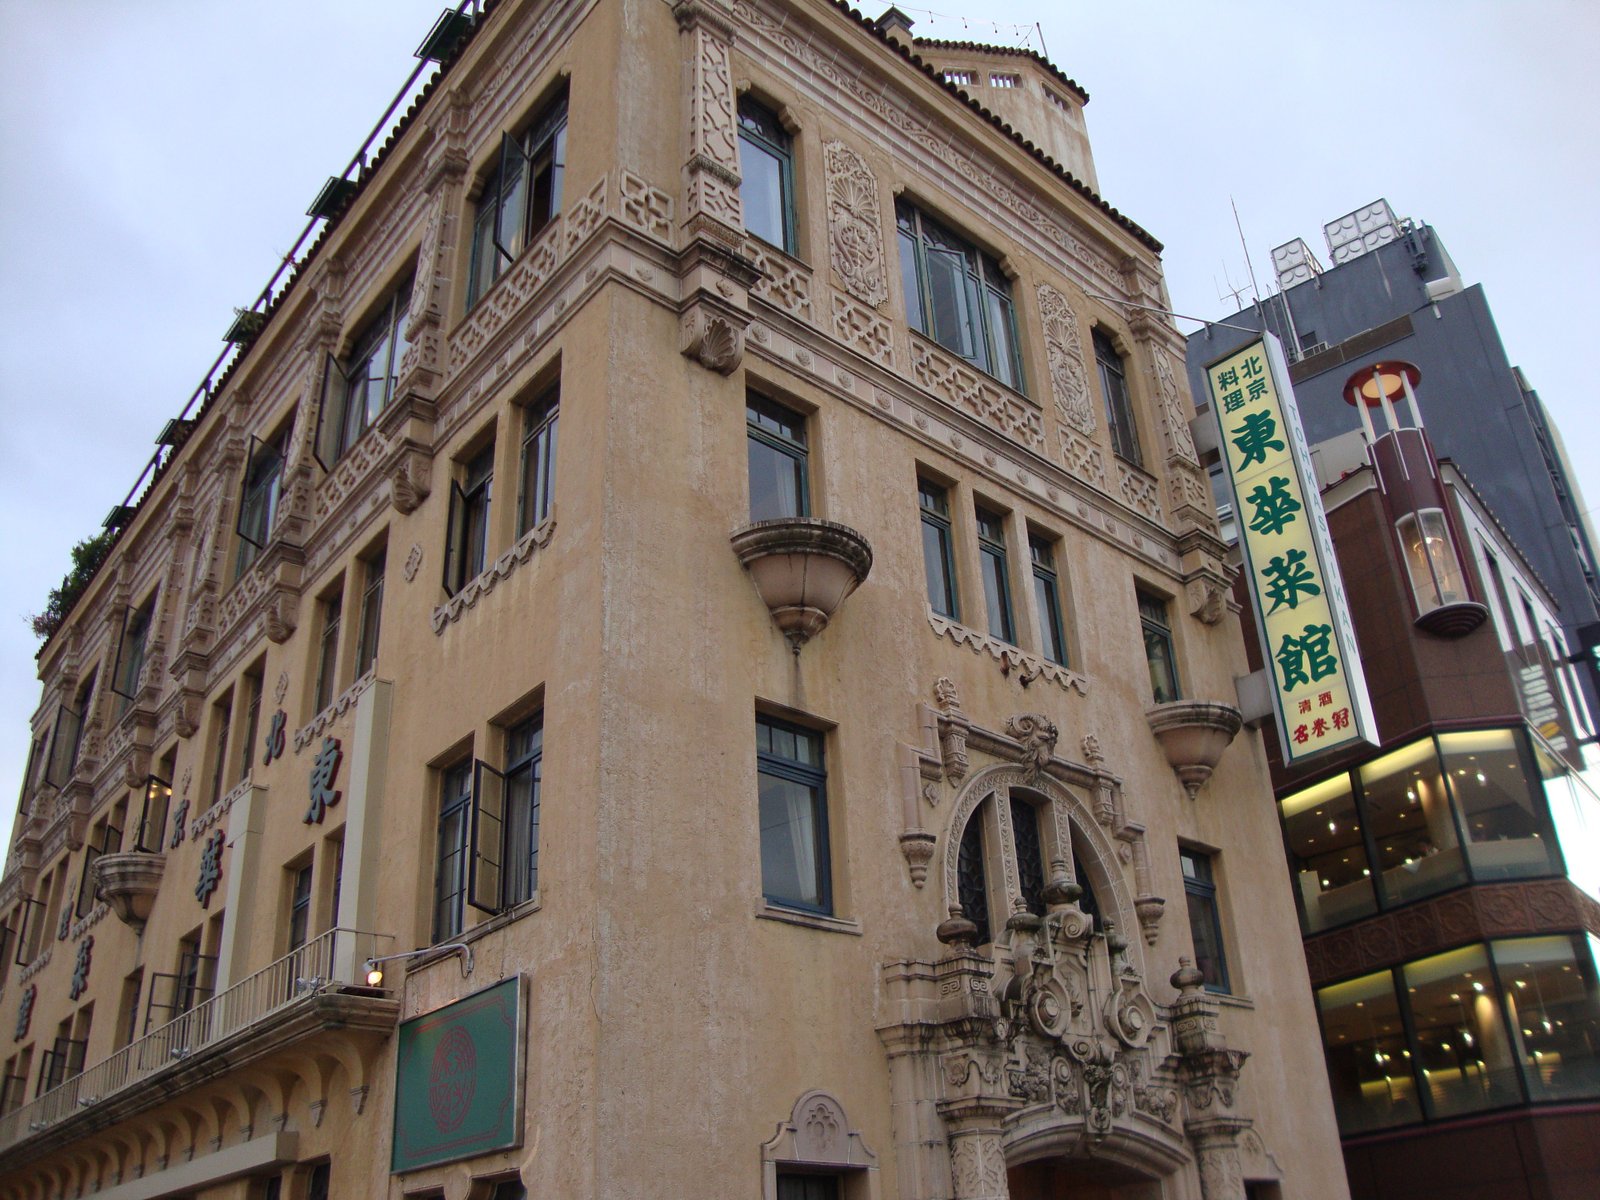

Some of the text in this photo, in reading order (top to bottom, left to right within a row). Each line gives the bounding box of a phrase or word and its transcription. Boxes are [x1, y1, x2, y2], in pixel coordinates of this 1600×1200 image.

[1218, 366, 1246, 414] 料理
[1241, 356, 1268, 402] 北京
[1231, 409, 1338, 692] 東華菜館
[1298, 691, 1333, 714] 清酒
